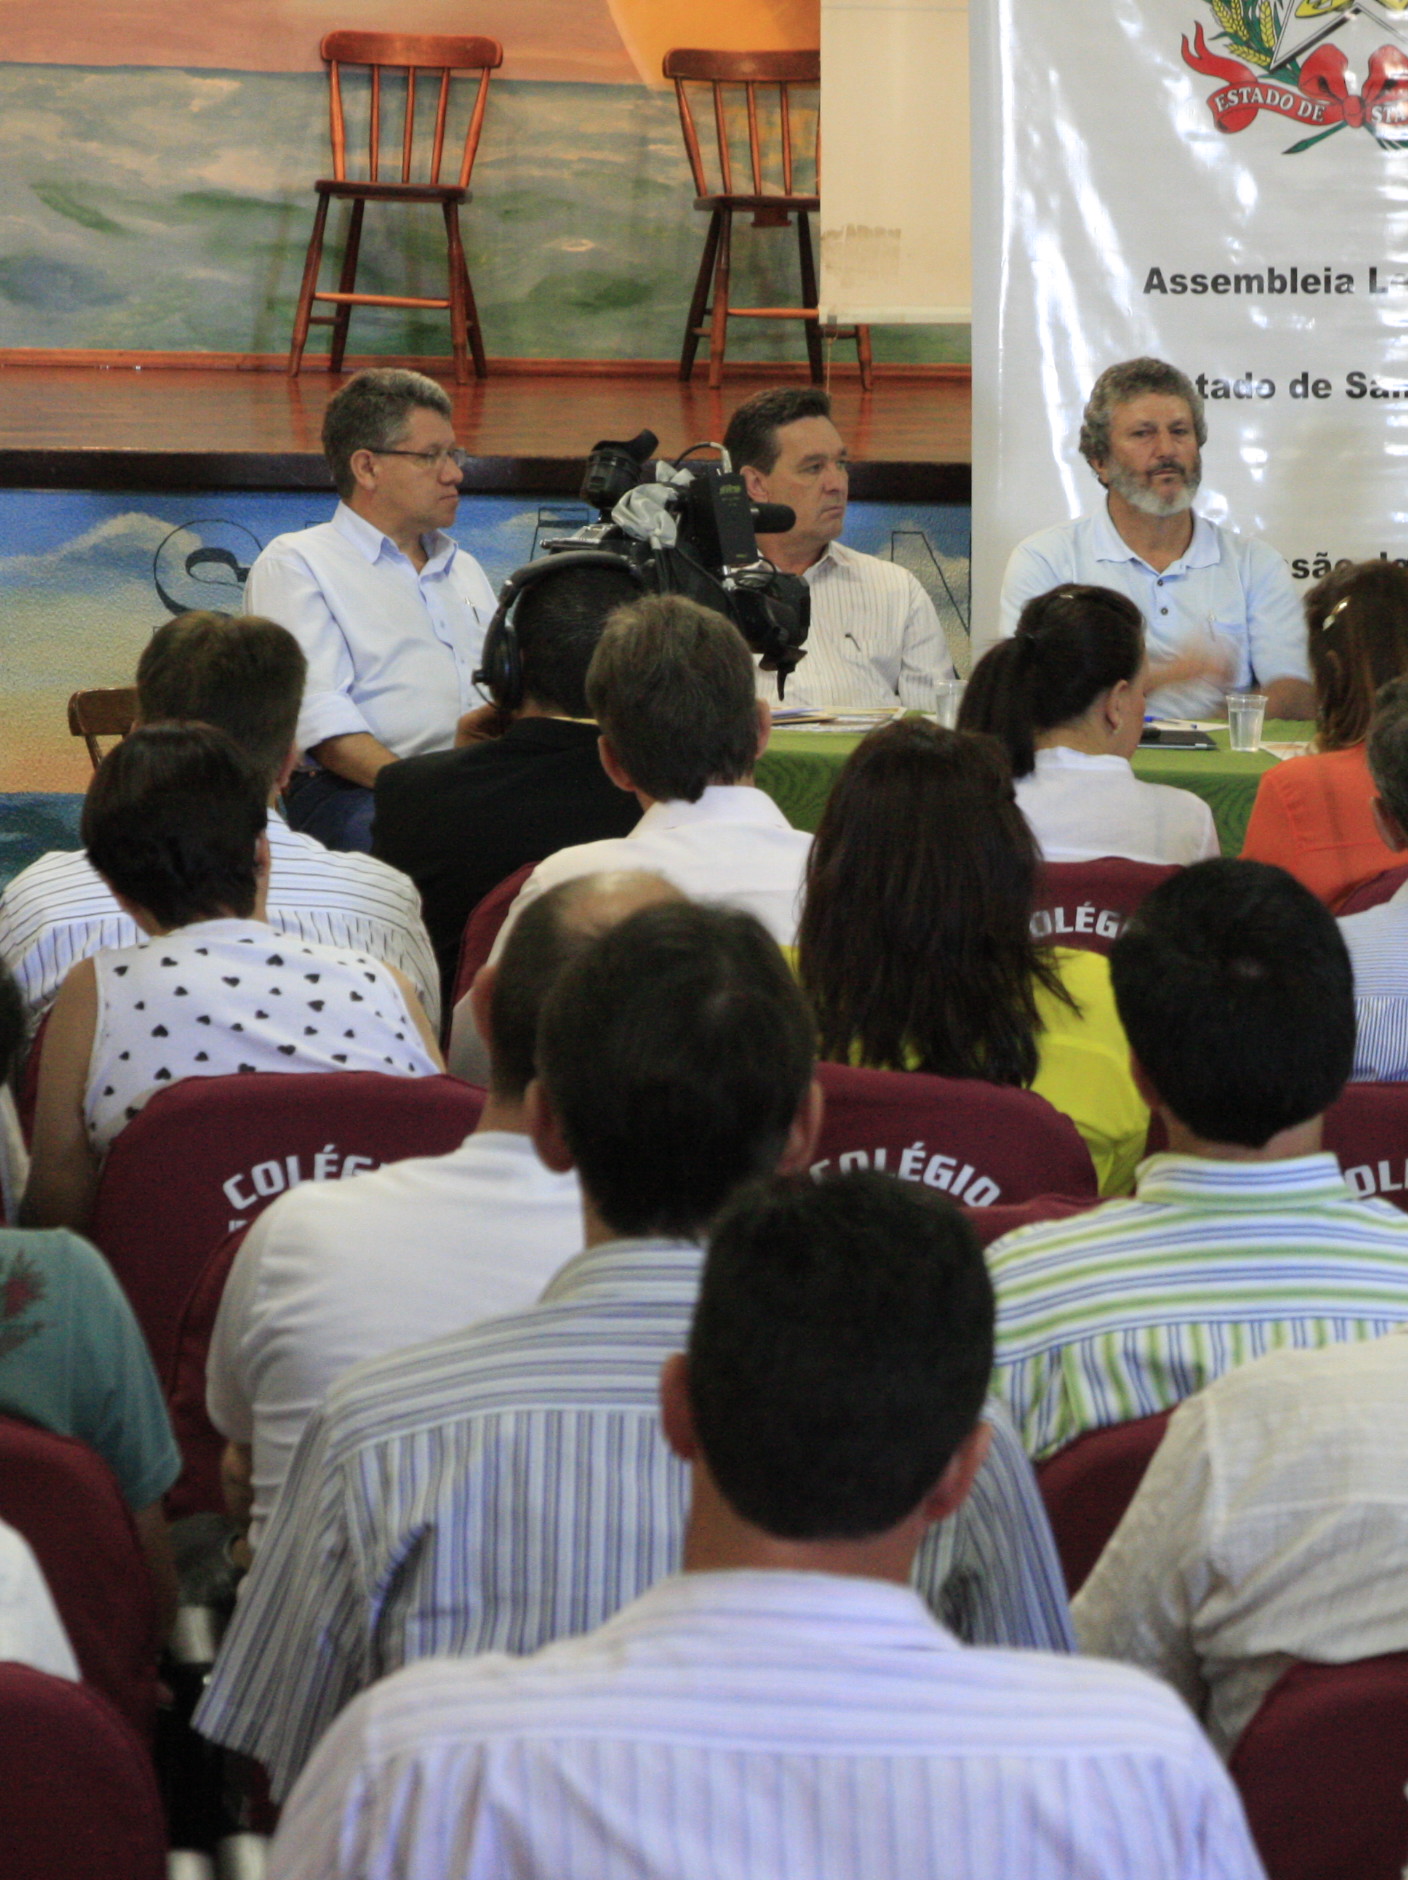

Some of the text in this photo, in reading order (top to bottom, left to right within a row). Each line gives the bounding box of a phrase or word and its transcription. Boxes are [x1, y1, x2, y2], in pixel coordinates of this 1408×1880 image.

[1214, 87, 1293, 113] ESTADO
[1299, 101, 1327, 122] DE
[1143, 266, 1355, 295] Assembleia
[1195, 371, 1276, 399] tado
[1289, 371, 1332, 399] de
[1029, 901, 1130, 939] OLÉG
[222, 1144, 388, 1211] COLÉG
